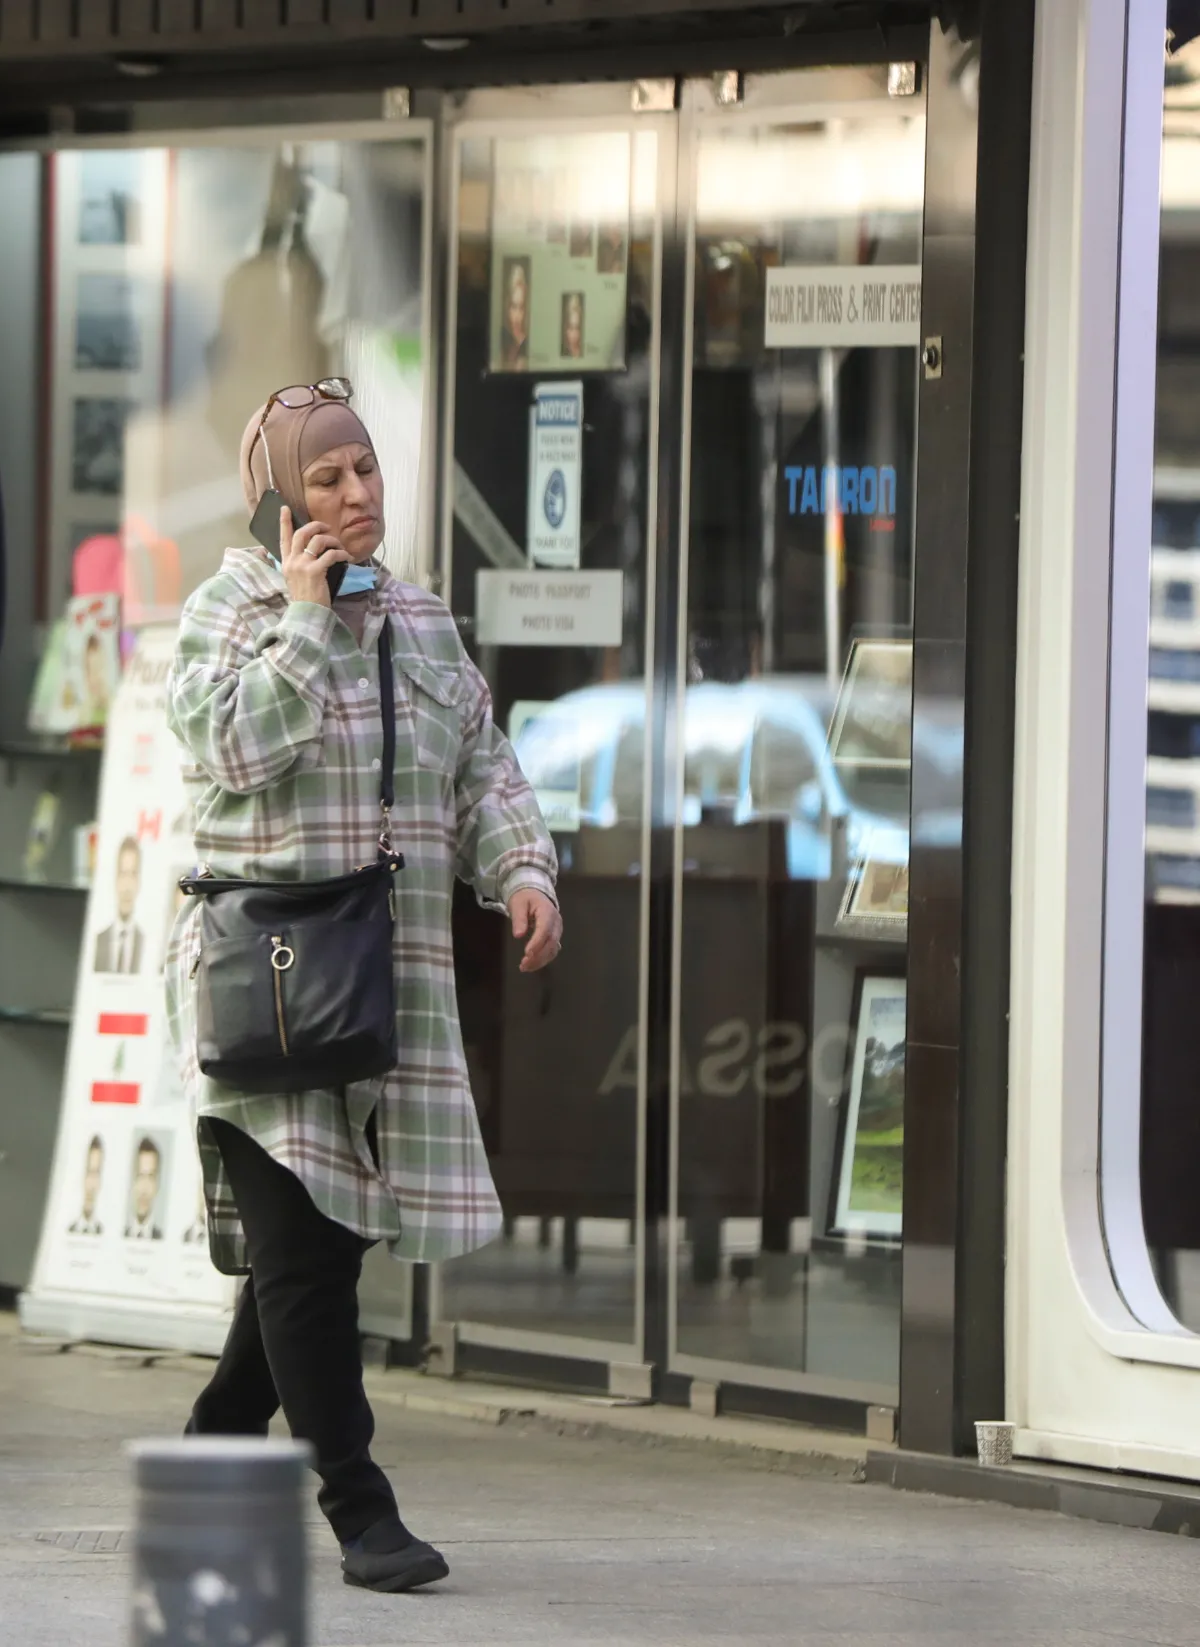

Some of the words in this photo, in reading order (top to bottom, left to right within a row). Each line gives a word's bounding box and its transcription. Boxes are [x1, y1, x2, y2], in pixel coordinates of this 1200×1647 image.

[768, 284, 795, 323] COLOR
[797, 285, 815, 323] FILM
[847, 284, 859, 323] &
[862, 283, 887, 323] PRINT
[540, 401, 577, 420] NOTICE
